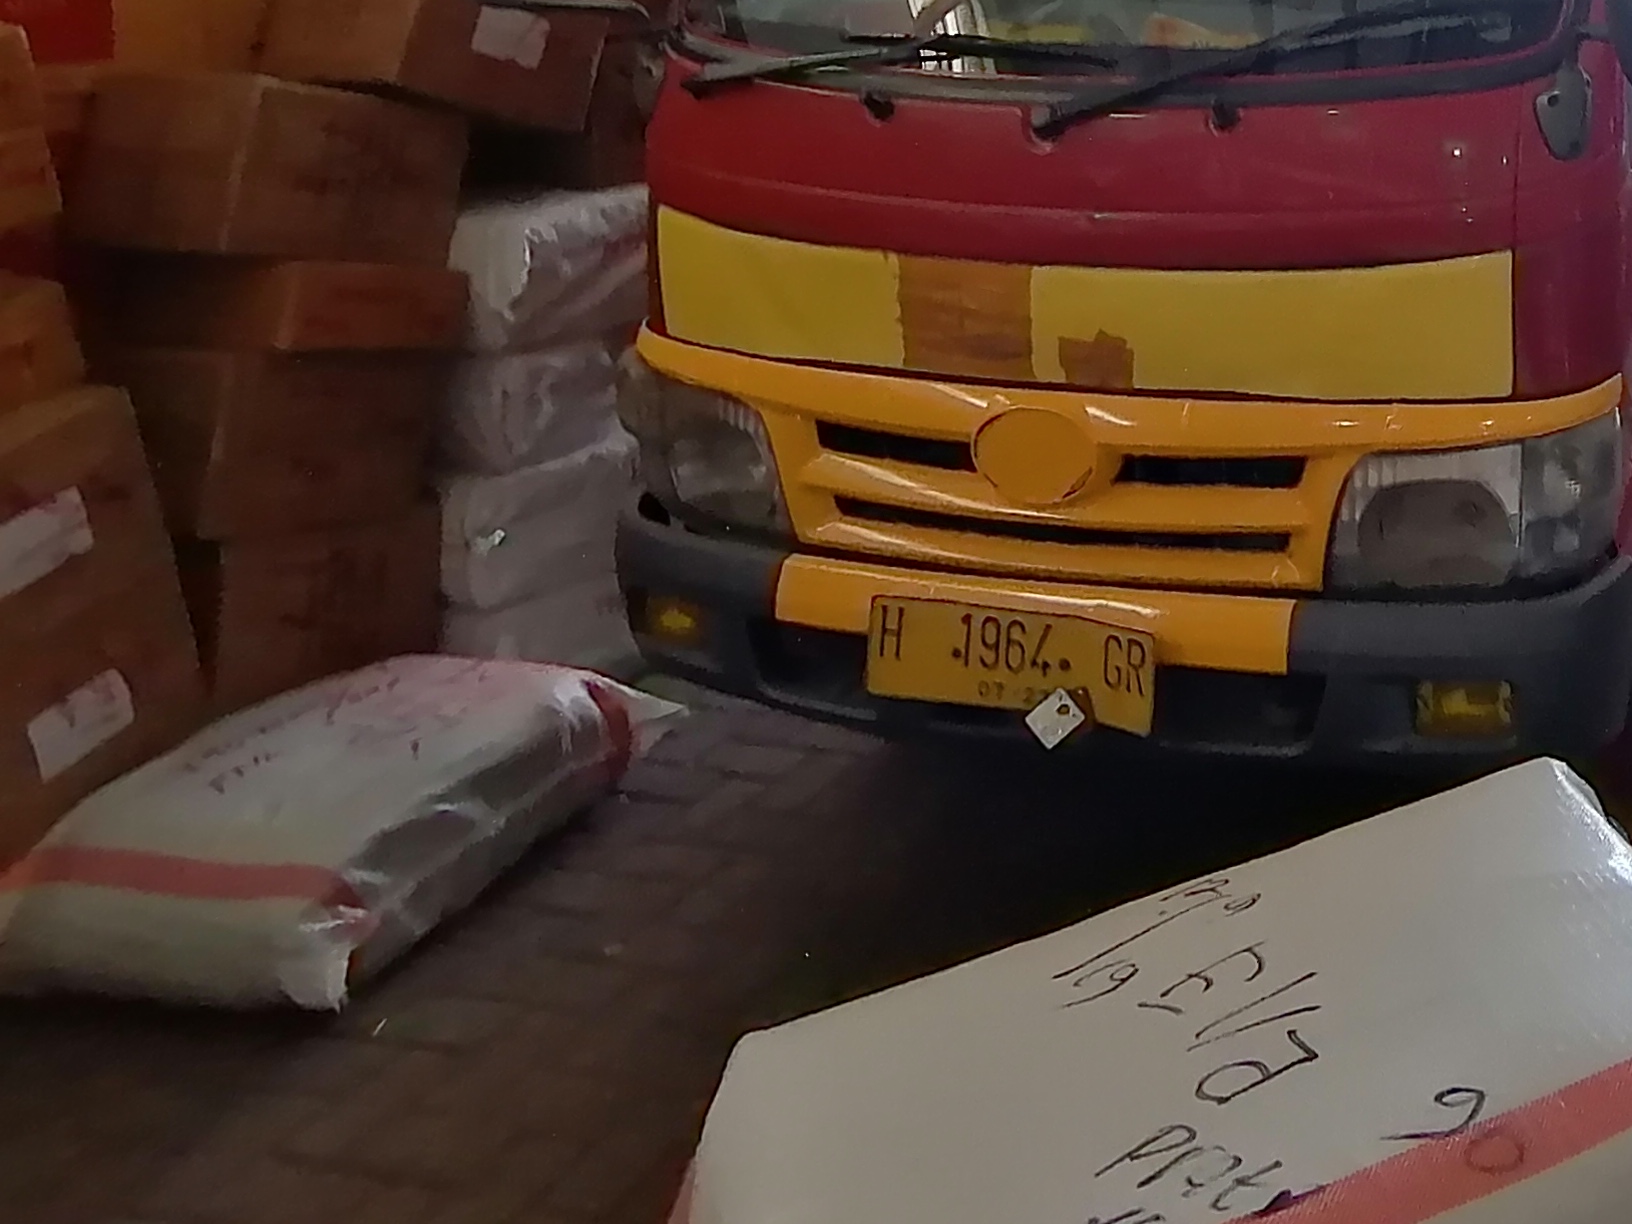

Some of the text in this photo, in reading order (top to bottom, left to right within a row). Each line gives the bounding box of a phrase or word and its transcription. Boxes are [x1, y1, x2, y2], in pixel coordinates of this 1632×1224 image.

[880, 606, 1146, 697] H 1964 GR
